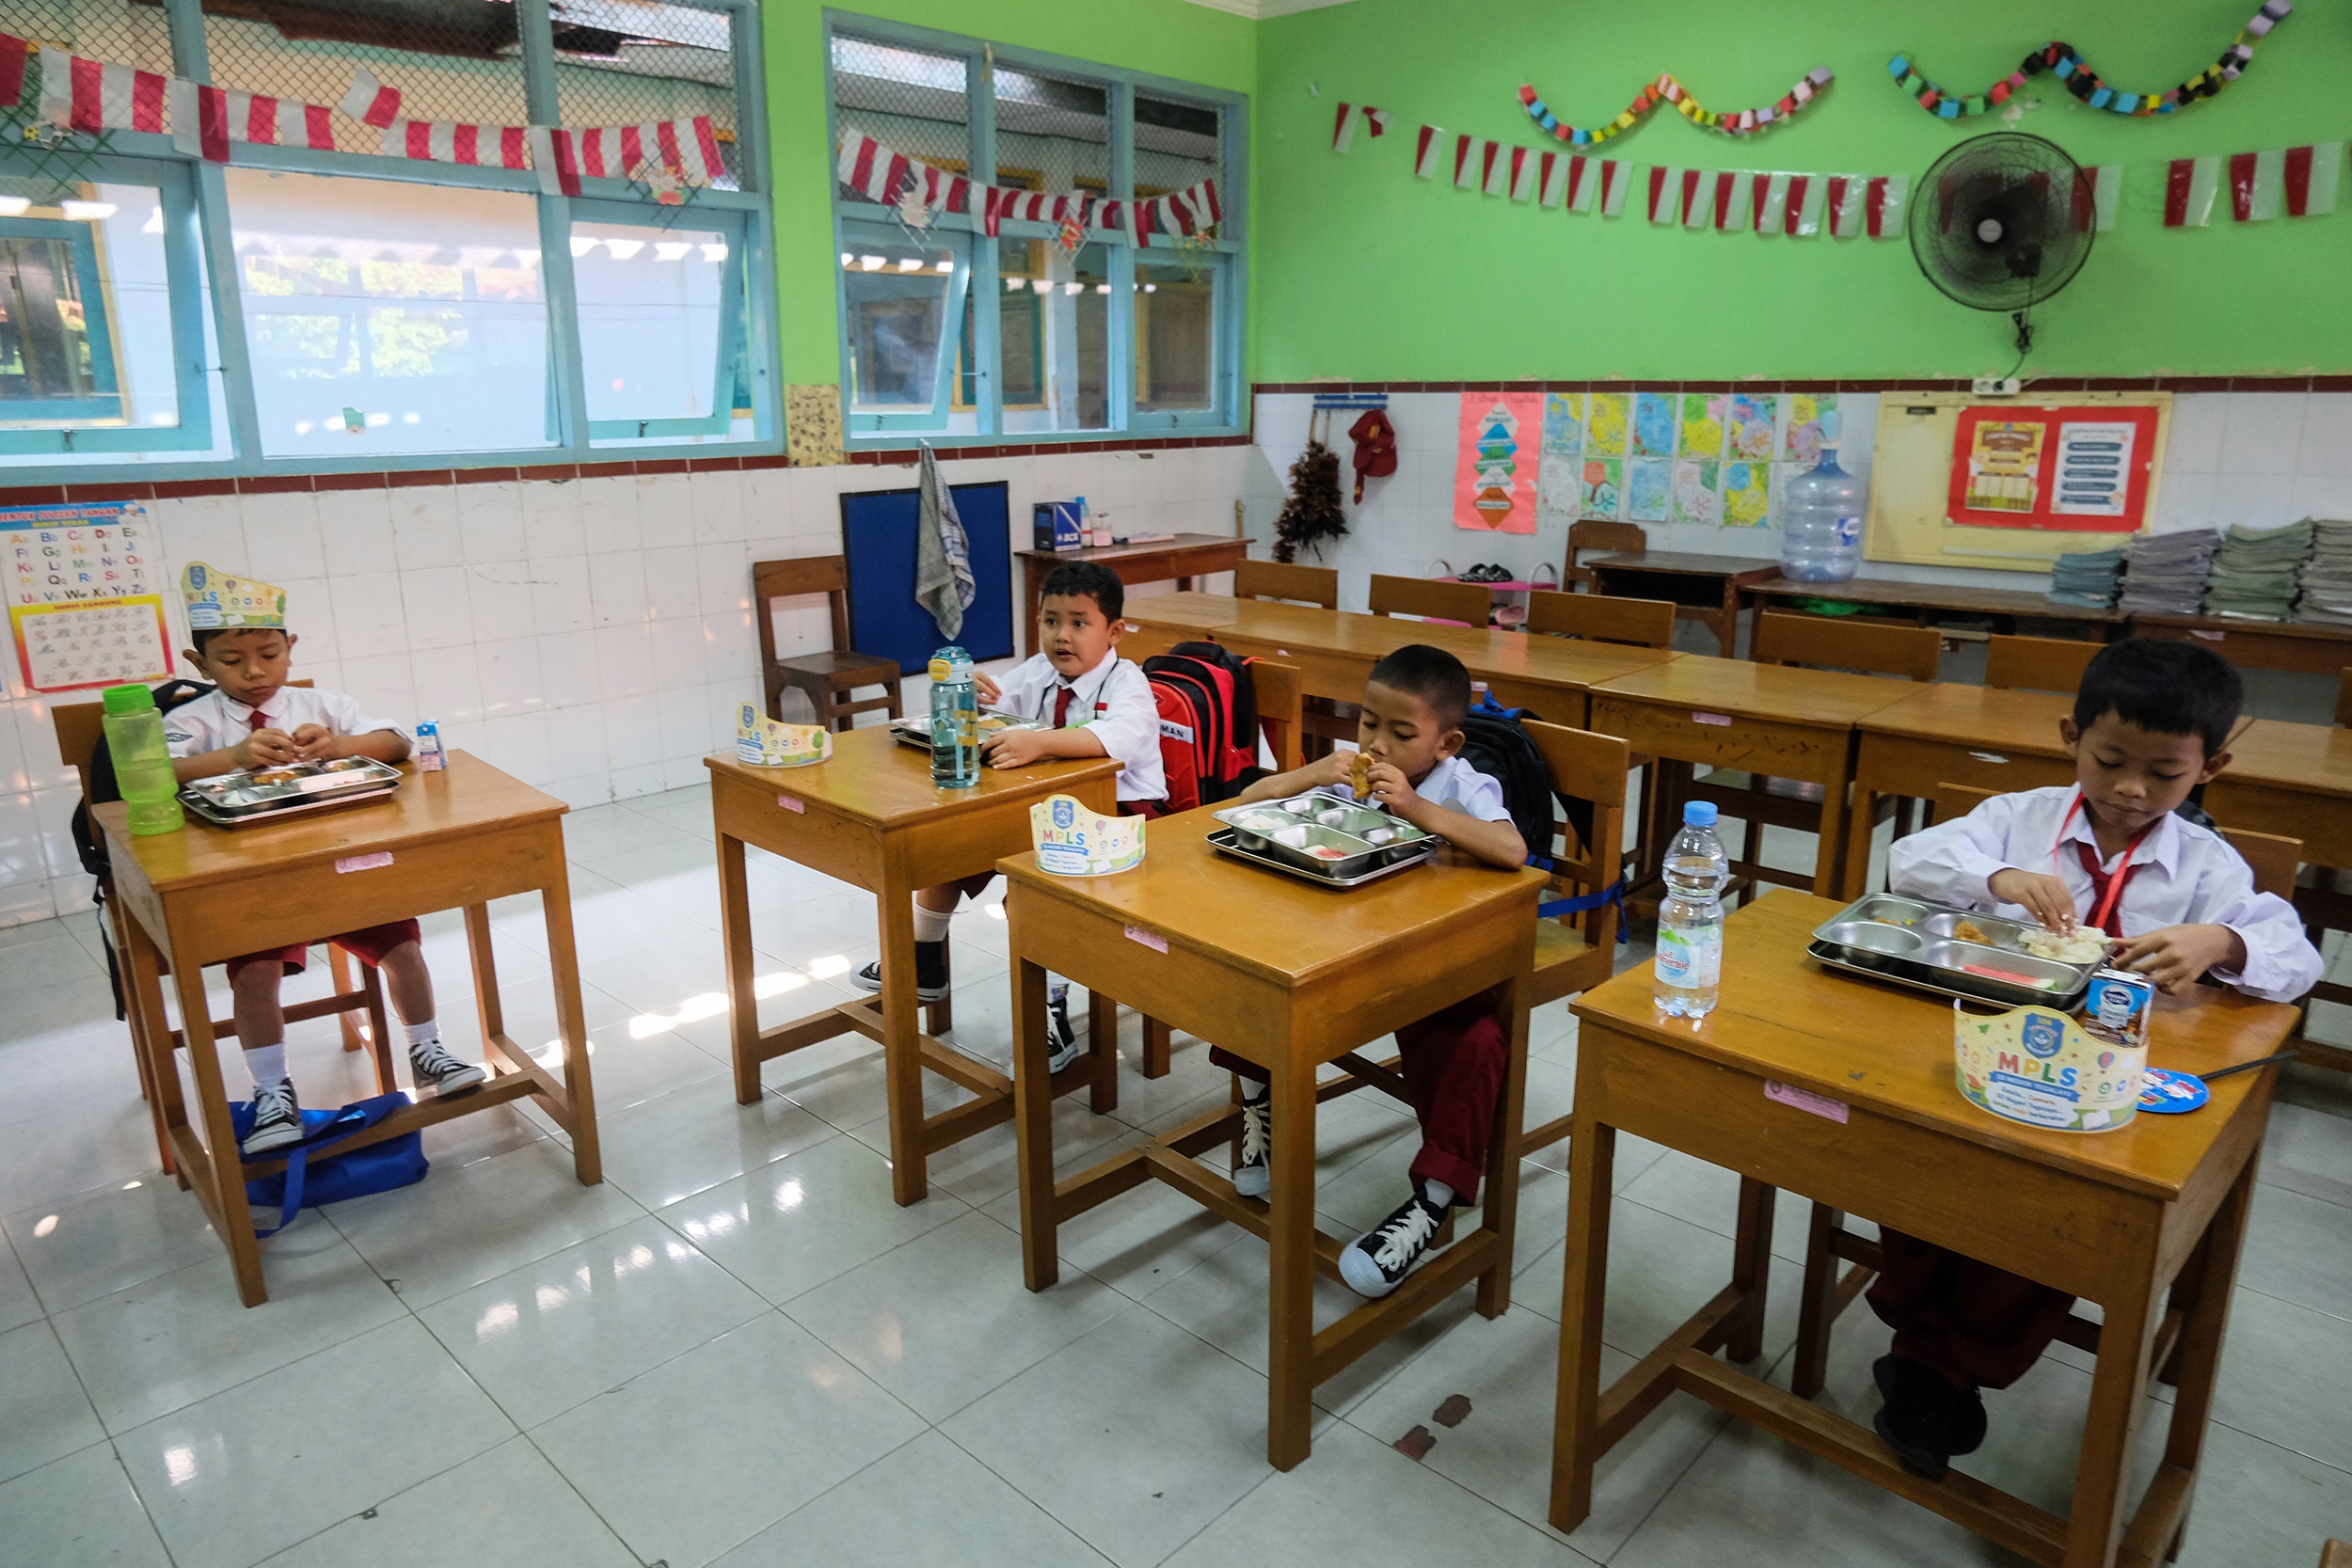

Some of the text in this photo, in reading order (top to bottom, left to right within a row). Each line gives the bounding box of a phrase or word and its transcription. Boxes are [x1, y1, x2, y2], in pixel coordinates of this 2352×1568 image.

[1160, 724, 1184, 738] MAN
[1043, 829, 1085, 846] MPLS
[1998, 1051, 2079, 1087] MPLS
